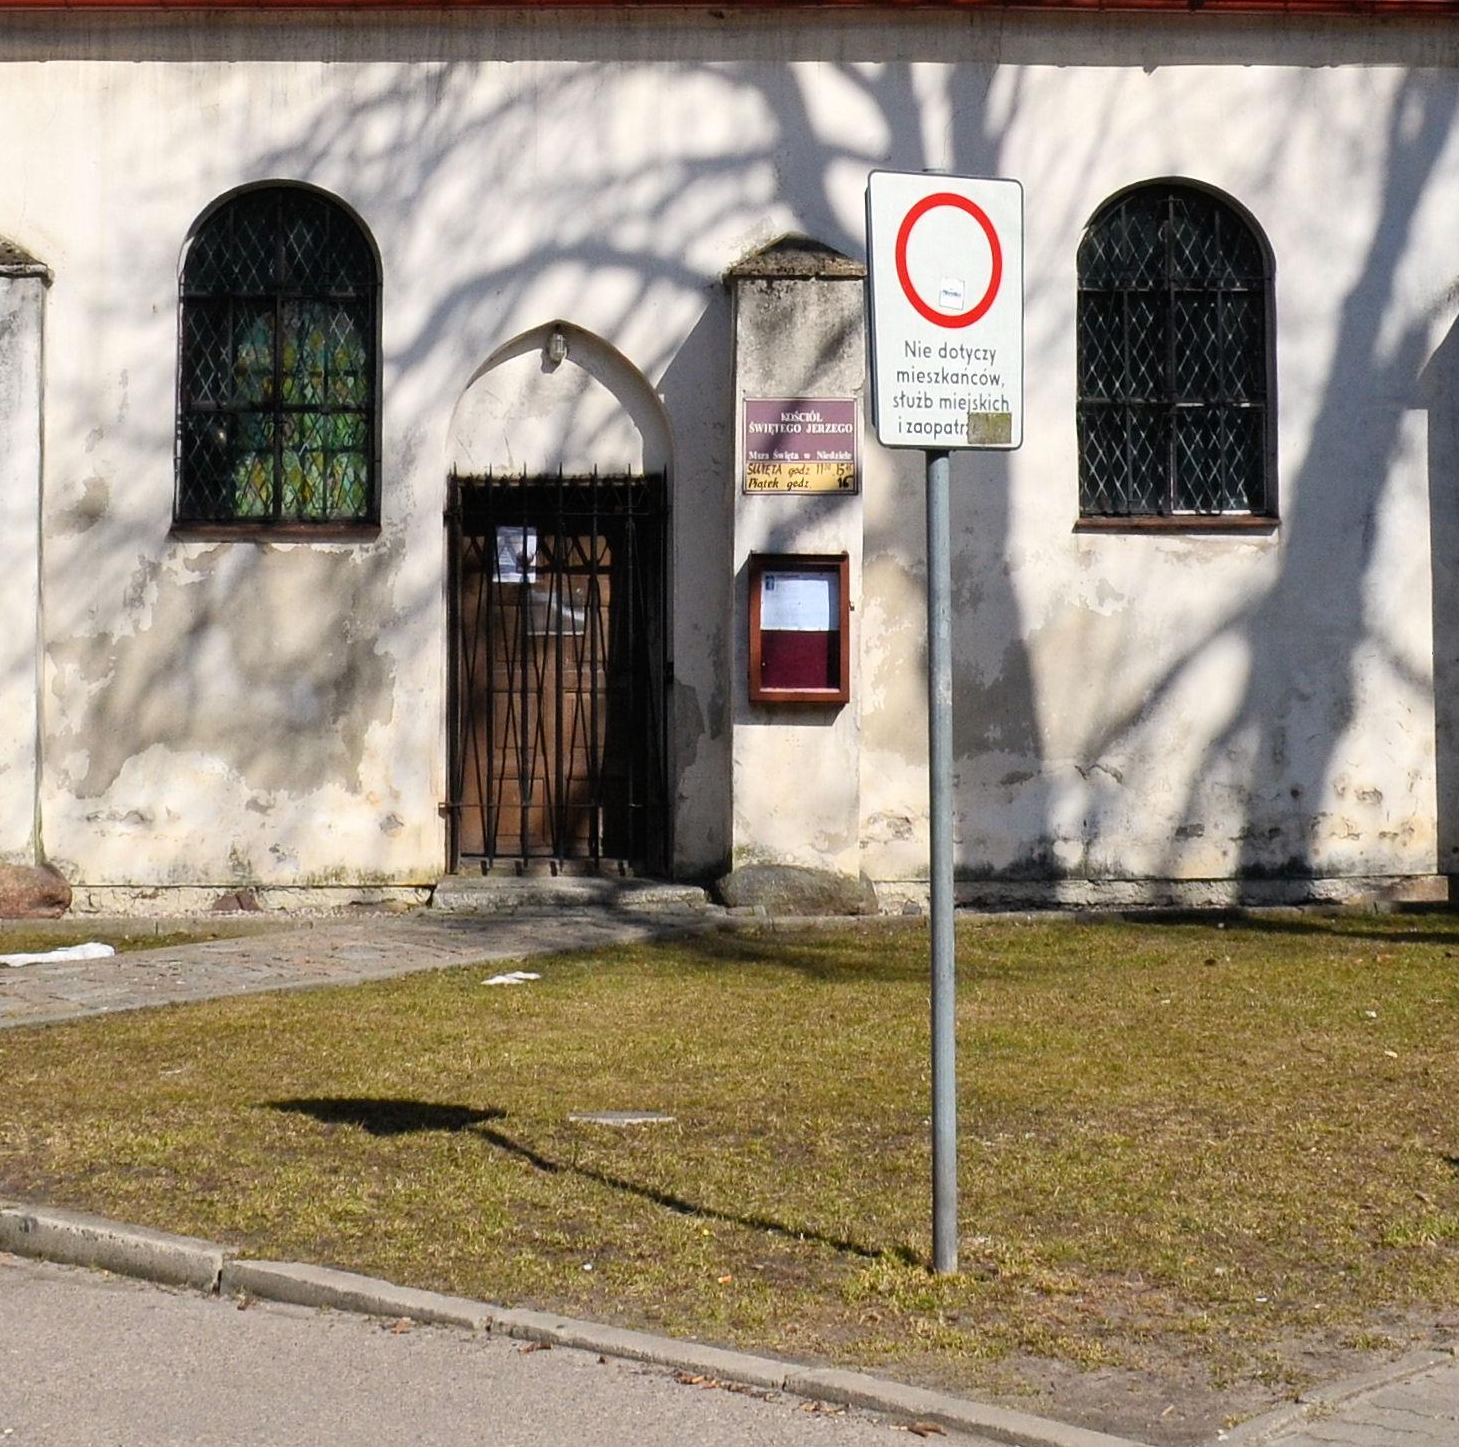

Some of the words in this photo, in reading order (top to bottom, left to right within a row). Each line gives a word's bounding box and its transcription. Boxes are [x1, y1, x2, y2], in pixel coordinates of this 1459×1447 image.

[904, 340, 932, 359] Nie
[938, 341, 996, 366] dotyczy
[896, 365, 1005, 388] mieszkańców,
[893, 390, 934, 409] służb
[939, 392, 1010, 414] miejskich
[748, 421, 802, 436] ŚWIĘTEGO
[806, 423, 854, 434] JERZEGO
[898, 415, 902, 434] i
[906, 418, 968, 441] zaopatr
